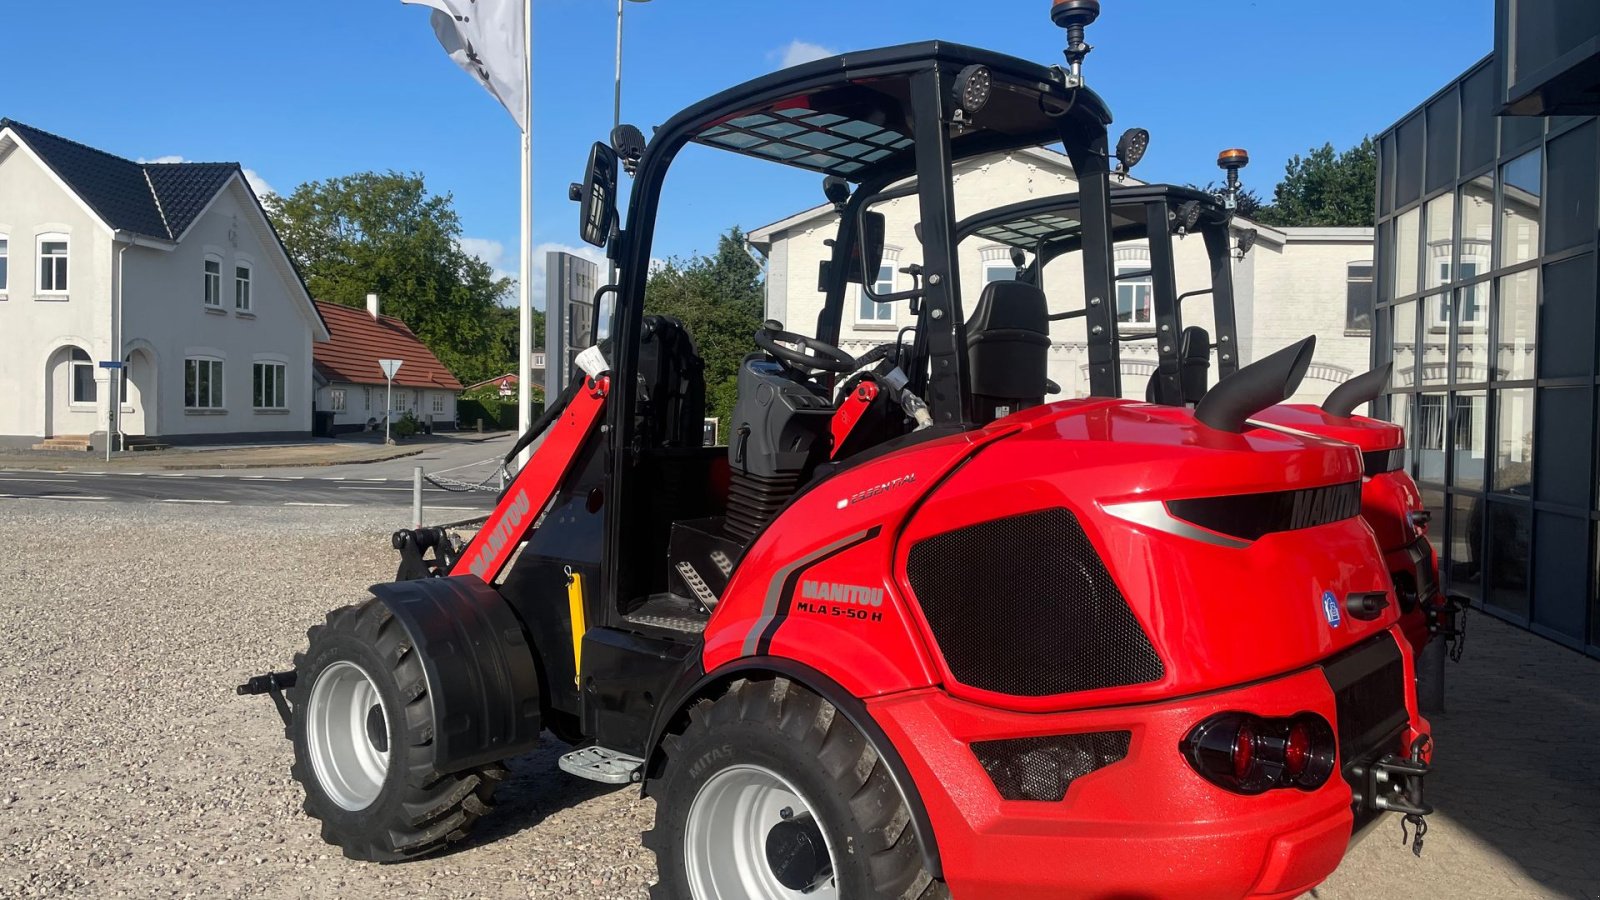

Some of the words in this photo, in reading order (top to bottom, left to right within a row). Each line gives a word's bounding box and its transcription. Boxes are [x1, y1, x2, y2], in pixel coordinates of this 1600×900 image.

[851, 473, 915, 504] ESSENTIAL
[802, 580, 884, 607] MANITOU
[797, 602, 827, 615] MLA
[831, 606, 868, 620] 5-50
[871, 612, 882, 622] H
[688, 744, 734, 779] MITAS
